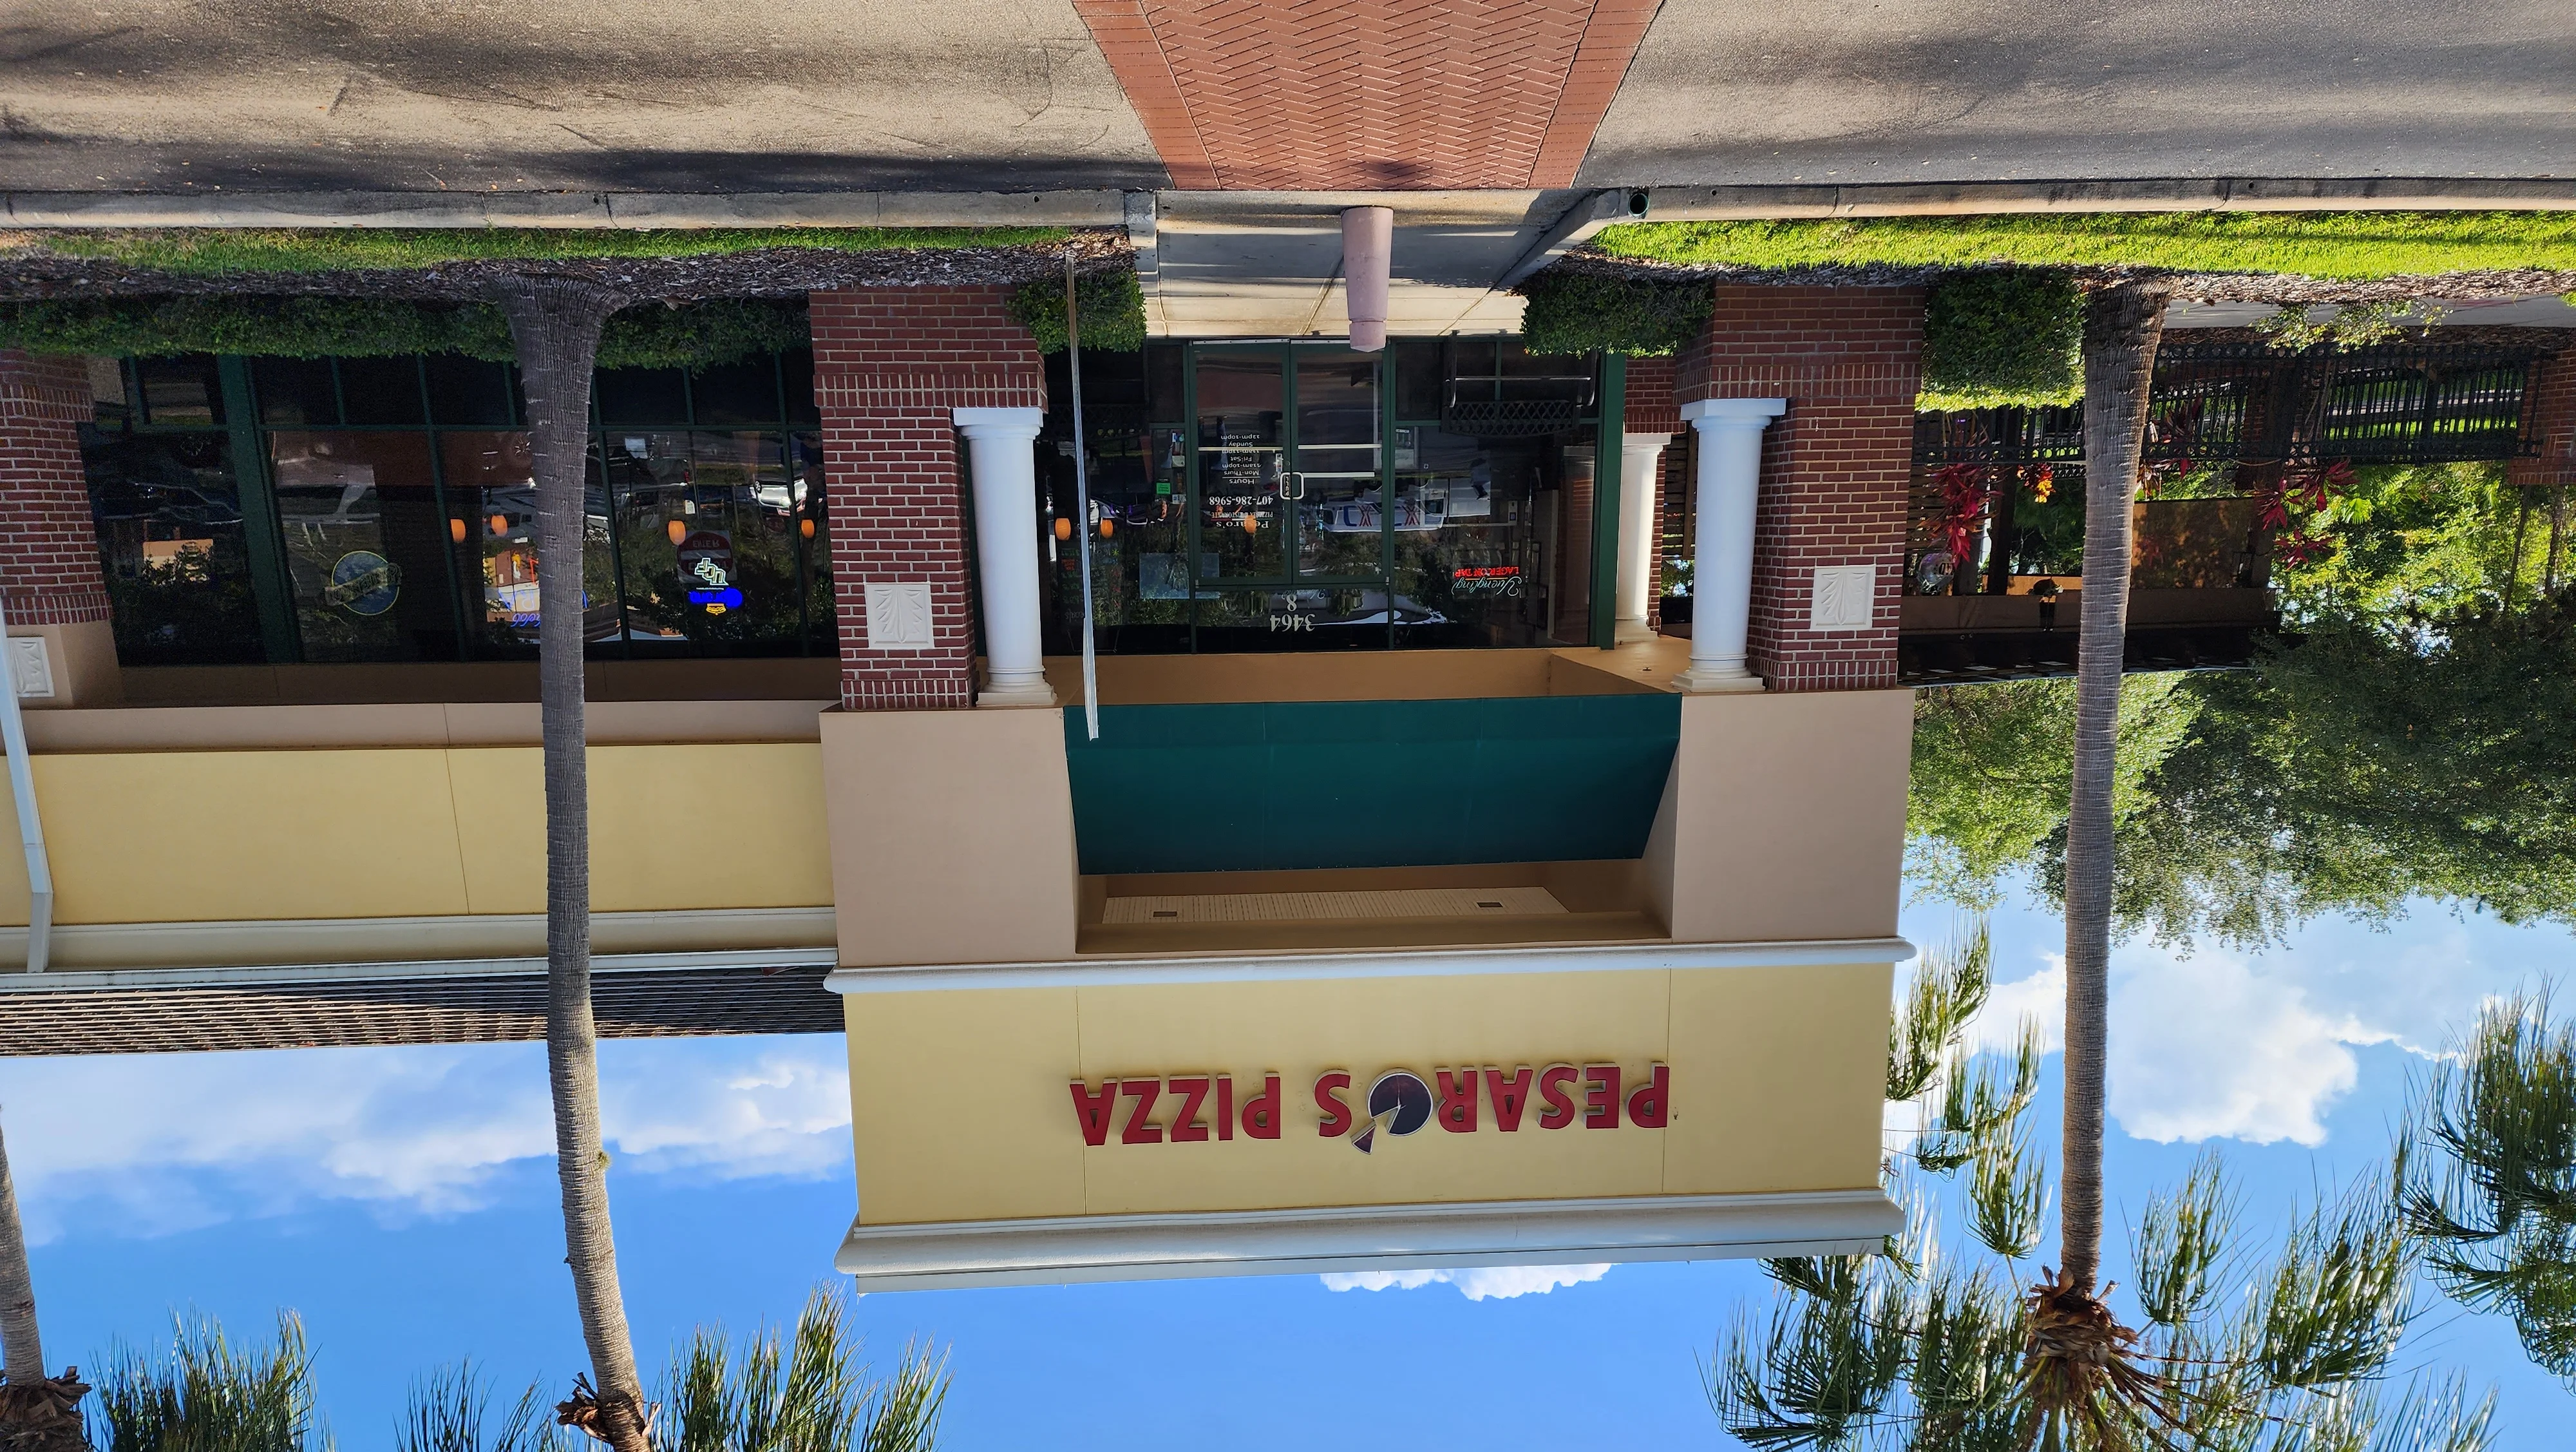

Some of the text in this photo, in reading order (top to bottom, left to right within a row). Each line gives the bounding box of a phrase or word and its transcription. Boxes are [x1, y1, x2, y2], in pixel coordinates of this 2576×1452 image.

[1209, 495, 1274, 505] 407-286-5968
[1216, 521, 1269, 529] Pearo's
[694, 557, 728, 586] UCF
[1454, 566, 1519, 577] LAGER ON TAP
[1451, 576, 1522, 597] Yuengling
[1286, 594, 1297, 612] 8
[1269, 613, 1315, 632] 3464
[1069, 1072, 1281, 1147] PIZZA
